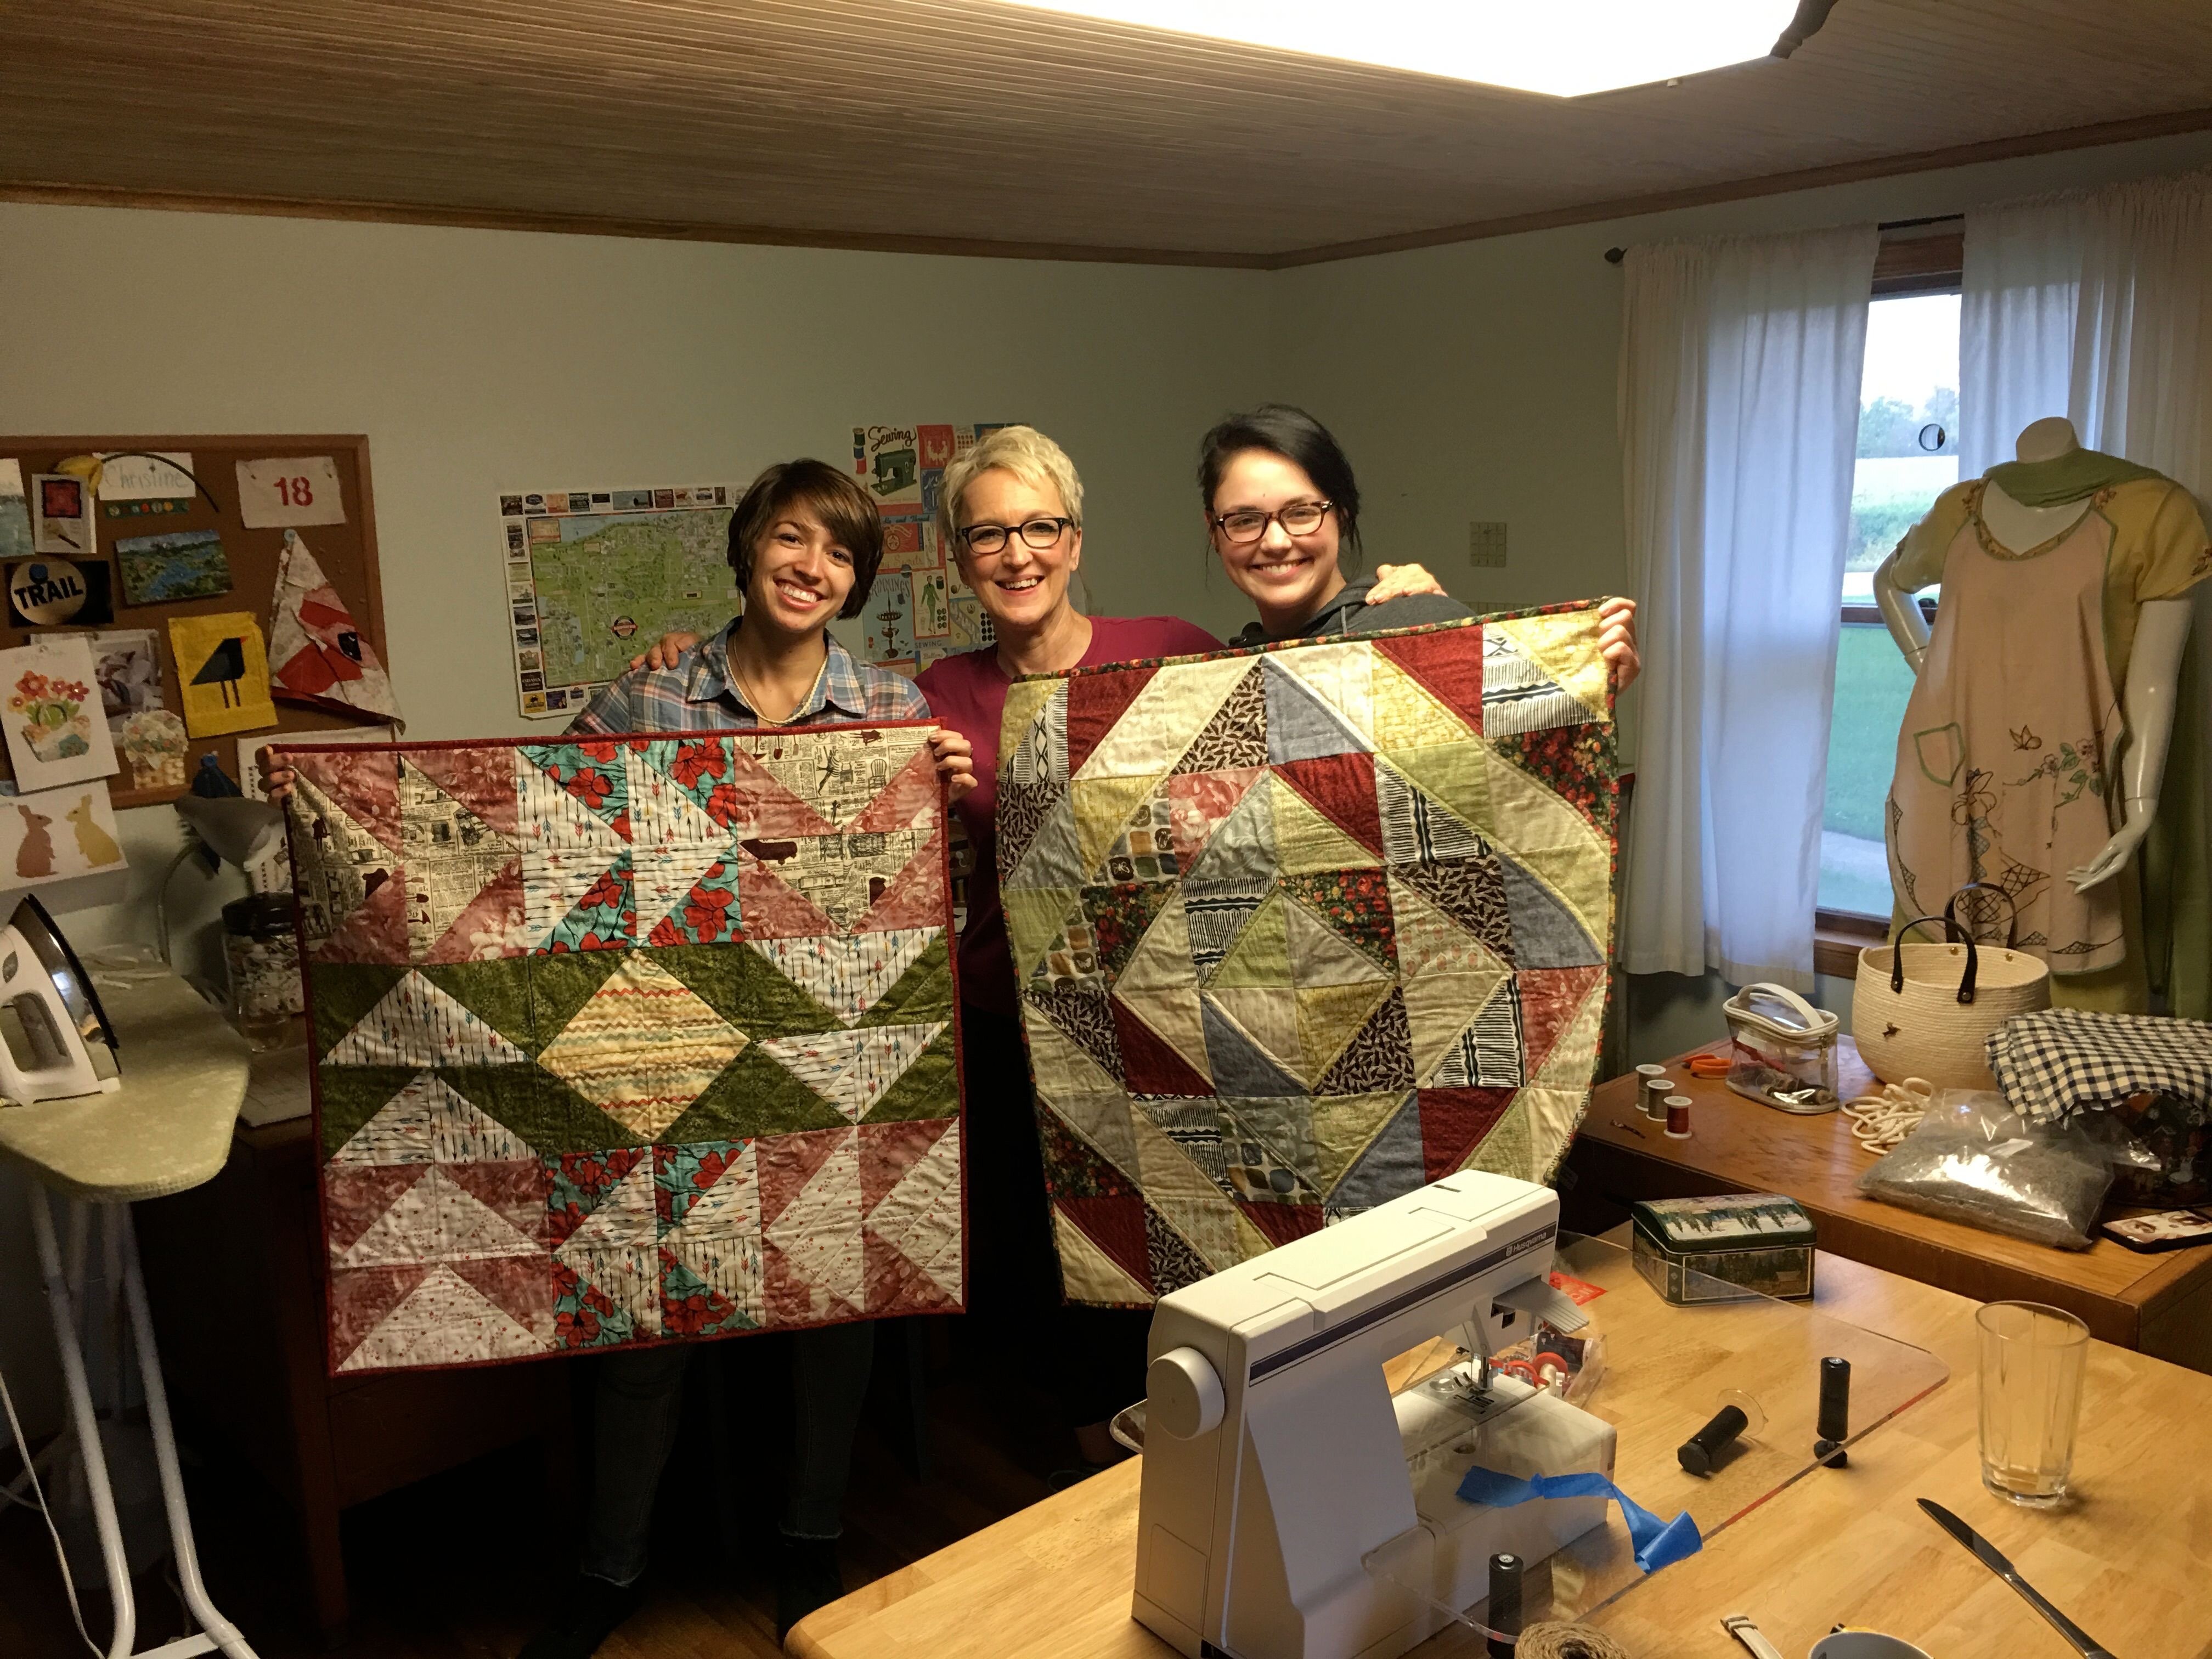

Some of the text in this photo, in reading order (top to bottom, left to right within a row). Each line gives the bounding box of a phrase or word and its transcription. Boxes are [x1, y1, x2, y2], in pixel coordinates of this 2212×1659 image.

[868, 426, 917, 452] Sewing
[105, 462, 189, 489] Christine
[274, 476, 314, 506] 18
[14, 576, 84, 610] TRAIL
[915, 640, 943, 649] SEWING
[1513, 1232, 1547, 1253] Husqvarna
